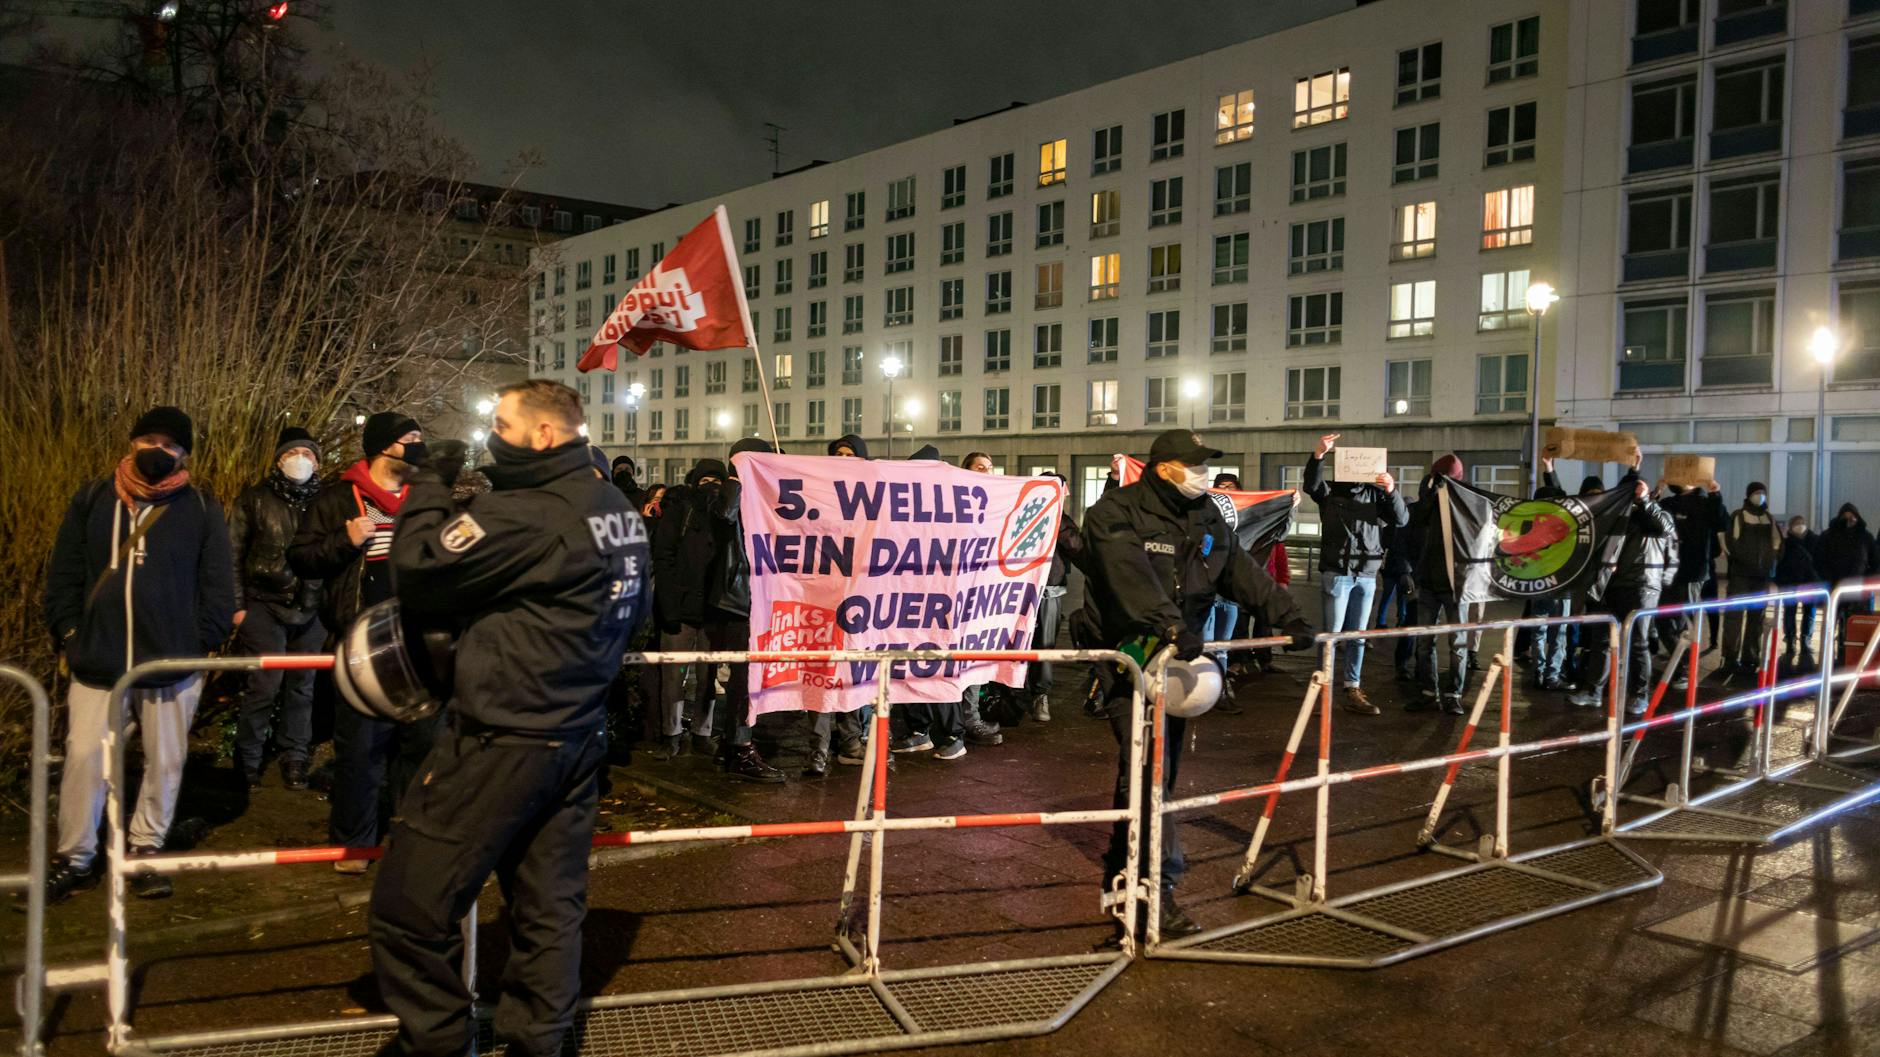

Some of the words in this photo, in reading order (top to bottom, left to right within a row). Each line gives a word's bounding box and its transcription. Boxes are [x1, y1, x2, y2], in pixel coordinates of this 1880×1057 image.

[775, 479, 819, 521] 5.
[834, 480, 988, 525] WELLE?
[751, 533, 855, 578] NEIN
[868, 536, 997, 578] DANKE!
[1499, 574, 1558, 592] AKTION
[771, 605, 824, 637] links
[835, 582, 1043, 635] QUERDENKEN
[802, 672, 844, 690] ROSA
